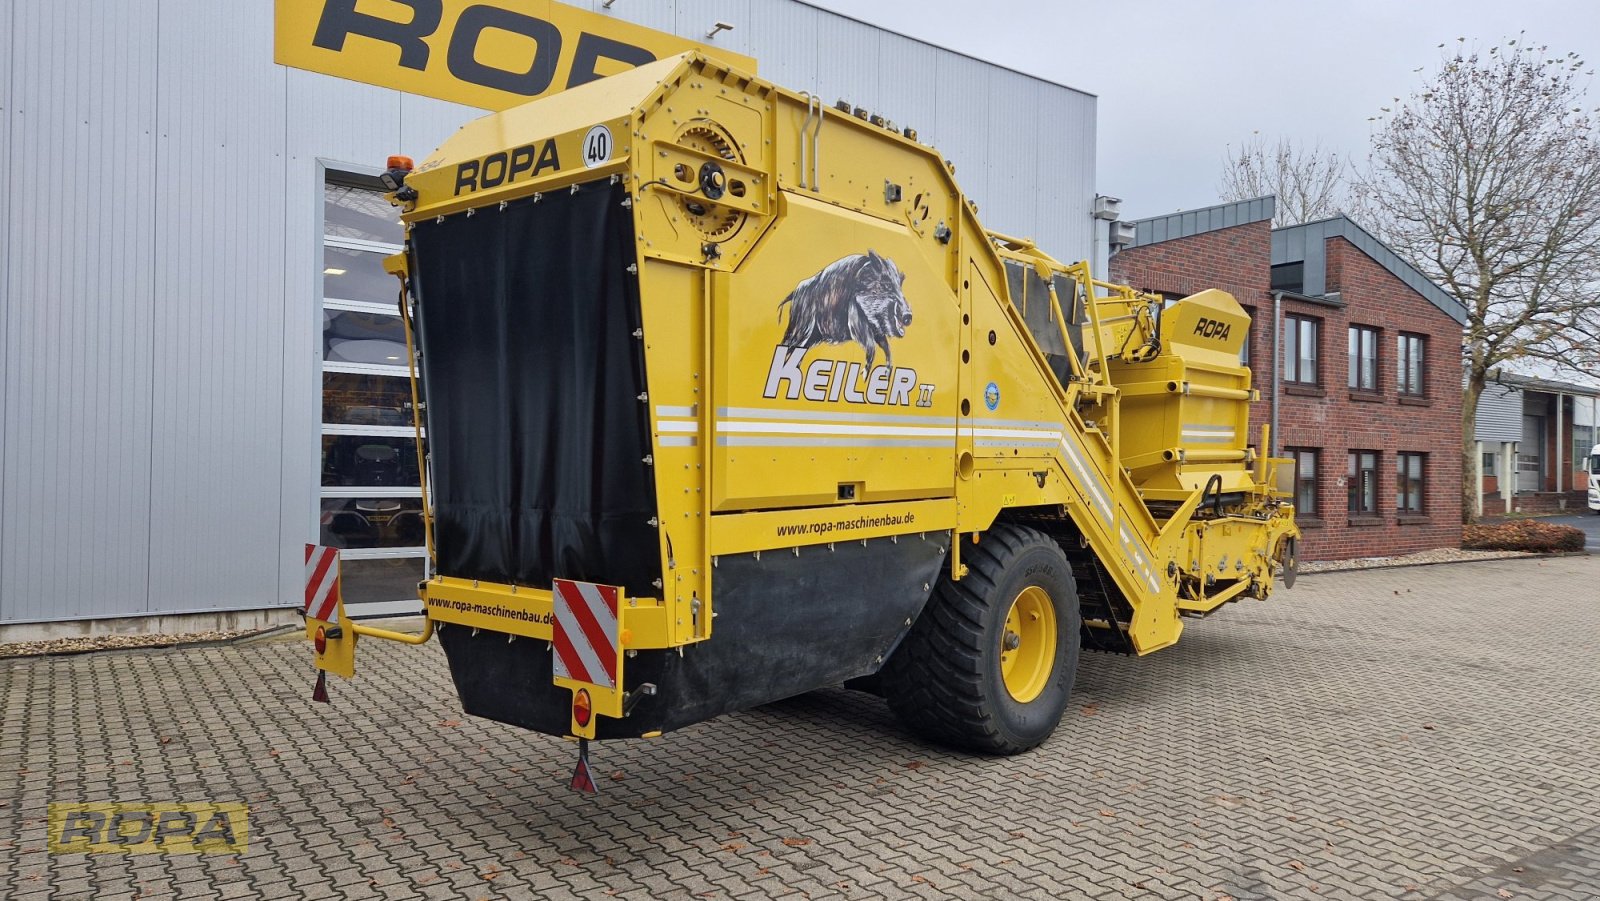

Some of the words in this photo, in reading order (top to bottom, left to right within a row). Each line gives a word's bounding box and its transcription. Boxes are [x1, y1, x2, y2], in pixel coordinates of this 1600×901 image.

[588, 132, 606, 162] 40
[454, 138, 560, 195] ROPA
[1193, 317, 1231, 341] ROPA
[777, 512, 915, 537] www.ropa-maschinenbau.de
[428, 597, 553, 625] www.ropa-maschinenbau.de
